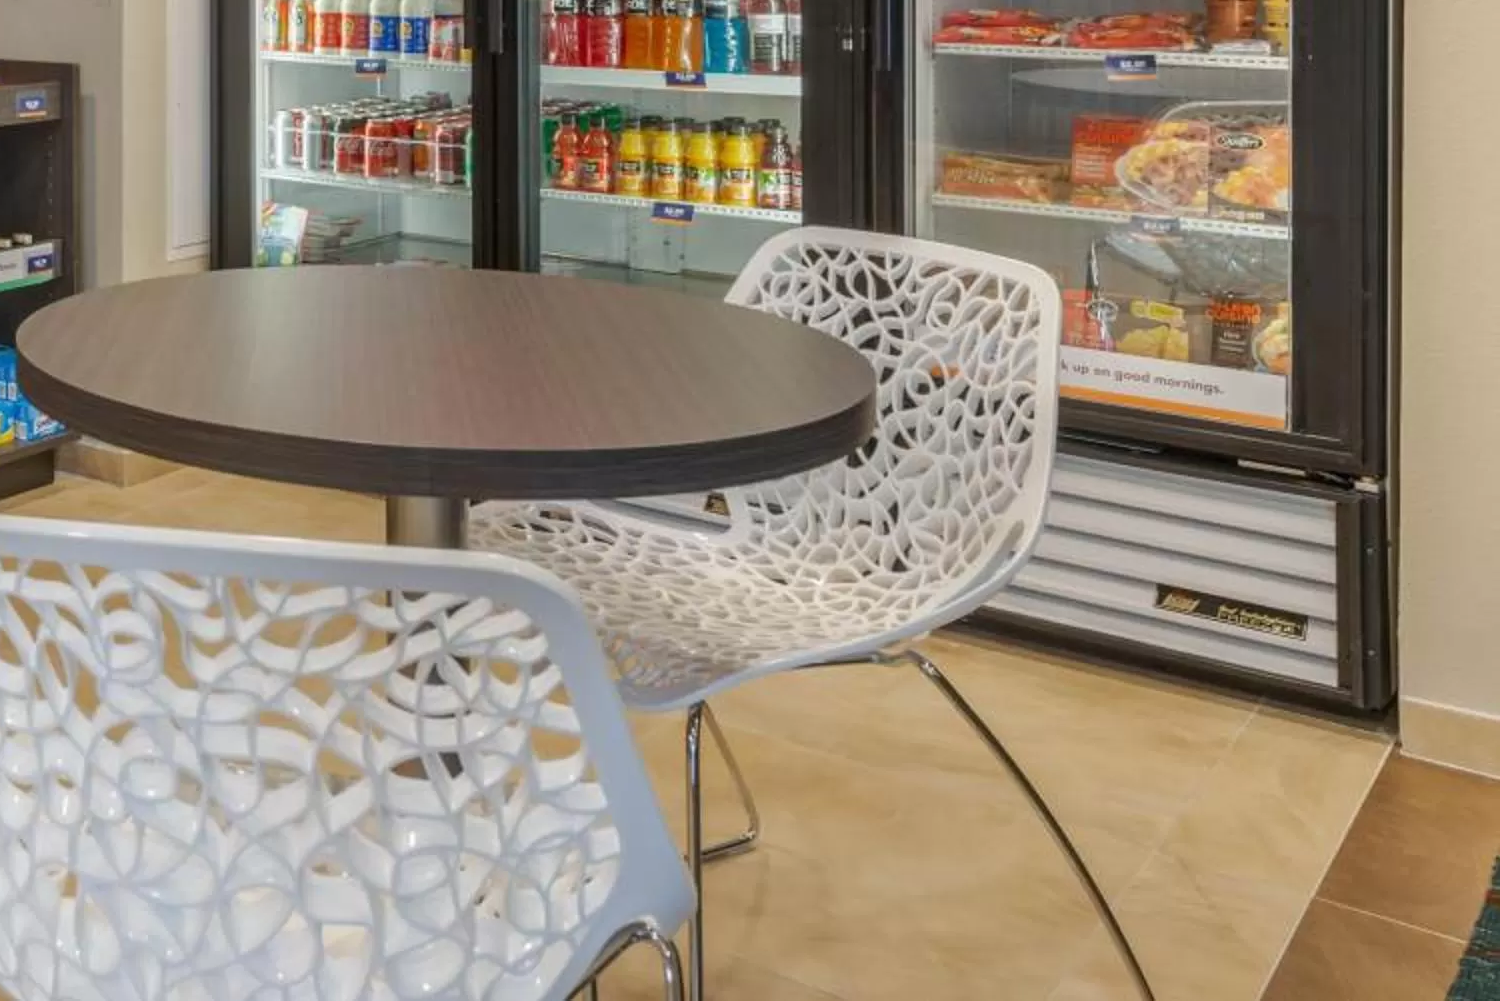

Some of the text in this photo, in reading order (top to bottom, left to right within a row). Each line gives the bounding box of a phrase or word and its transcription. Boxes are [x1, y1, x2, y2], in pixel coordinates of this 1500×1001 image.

[1072, 364, 1089, 376] up
[1093, 367, 1110, 377] on
[1114, 369, 1151, 384] good
[1153, 374, 1226, 396] mornings.
